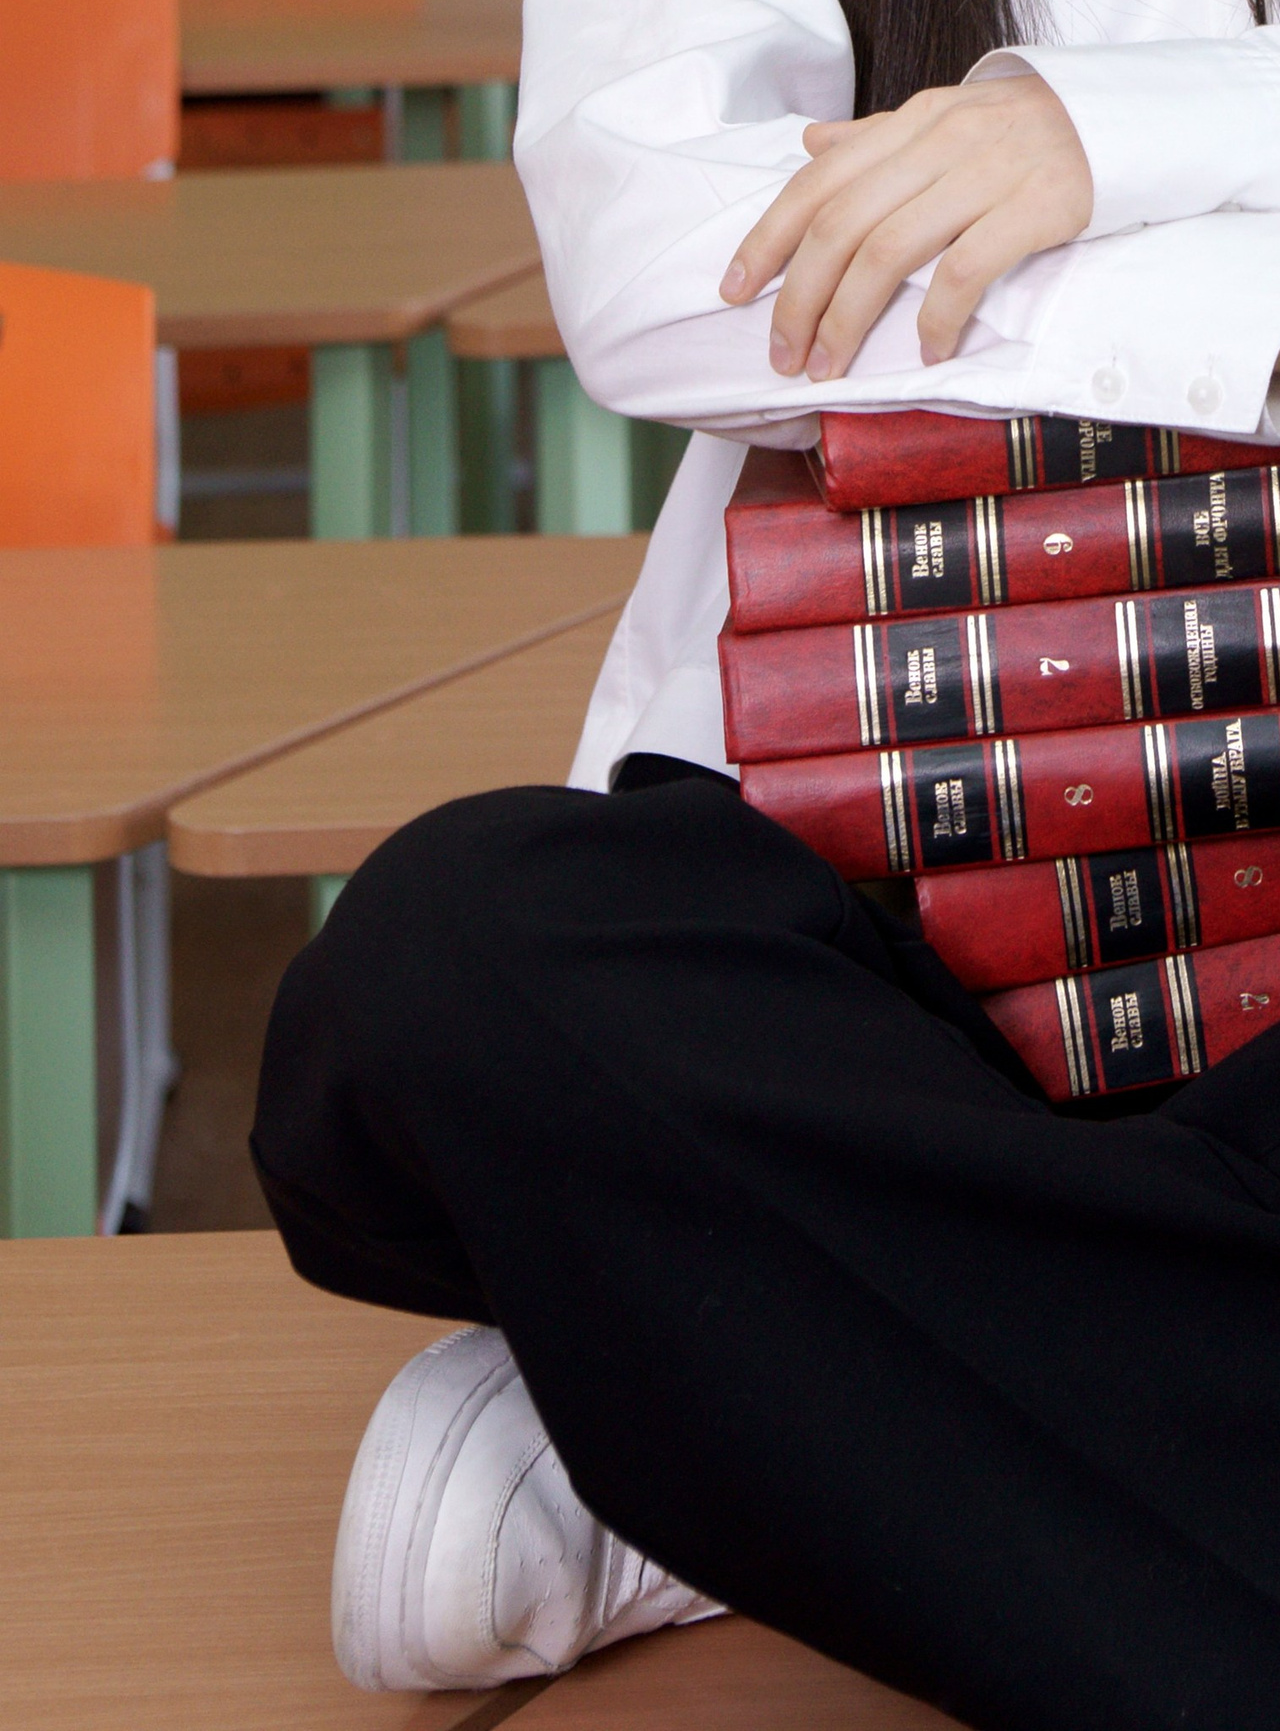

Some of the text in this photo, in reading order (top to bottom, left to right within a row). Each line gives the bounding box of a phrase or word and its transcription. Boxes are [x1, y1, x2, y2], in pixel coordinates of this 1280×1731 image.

[1095, 421, 1113, 443] СЕ
[912, 523, 929, 576] Венок
[928, 522, 944, 576] славы
[1043, 534, 1073, 554] 9
[1192, 510, 1212, 546] ВСЕ
[1208, 471, 1233, 578] ДЛЯ ФРОНТА
[904, 650, 923, 704] Венок
[921, 648, 937, 703] славы
[1040, 657, 1069, 675] 7
[1183, 599, 1204, 711] ОСВОБОЖДЕНИЕ
[1199, 624, 1218, 683] РОДИНЫ
[1224, 718, 1245, 772] ВРАГА
[947, 779, 967, 834] славы
[1064, 784, 1093, 806] 8
[1210, 750, 1230, 811] ВОЙНА
[1230, 775, 1248, 817] ТЫЛУ
[933, 782, 952, 837] Венок
[1109, 874, 1127, 931] Венок
[1124, 870, 1142, 926] славы
[1234, 865, 1263, 887] 8
[1109, 996, 1128, 1052] Венок
[1127, 992, 1143, 1048] славы
[1240, 992, 1270, 1009] 7
